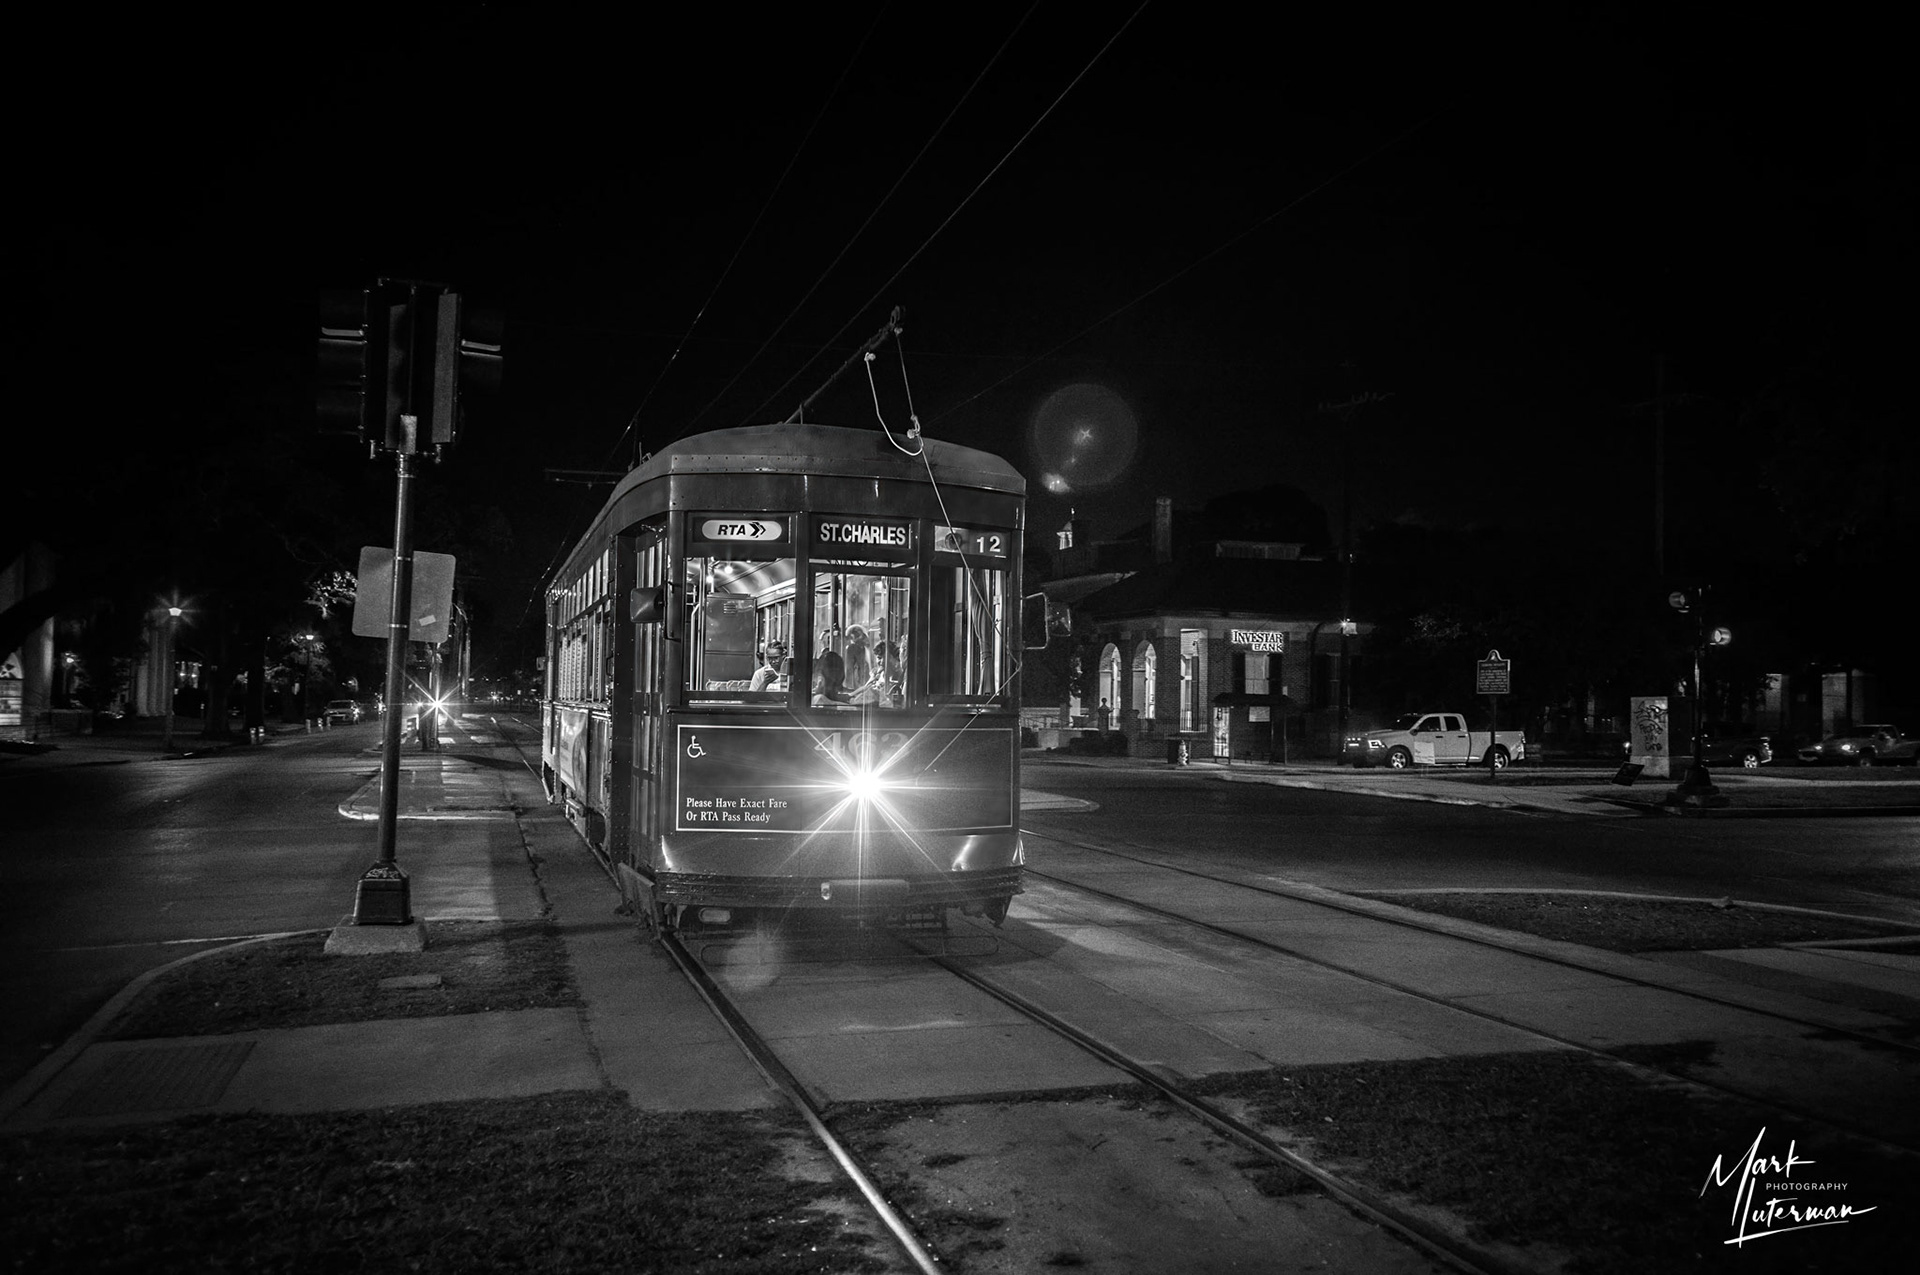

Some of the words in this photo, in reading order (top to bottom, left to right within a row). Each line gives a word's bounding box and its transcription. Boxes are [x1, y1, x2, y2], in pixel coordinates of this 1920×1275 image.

[717, 524, 747, 536] RTA
[976, 535, 1002, 553] 12
[1231, 629, 1284, 644] INVESTAR
[1252, 642, 1284, 653] BANK
[686, 797, 713, 808] Please
[715, 797, 737, 808] Have
[740, 798, 766, 809] Exact
[768, 798, 788, 809] Fare
[685, 810, 697, 822] Or
[700, 811, 719, 822] RTA
[722, 811, 741, 822] Pass
[744, 811, 771, 824] Ready
